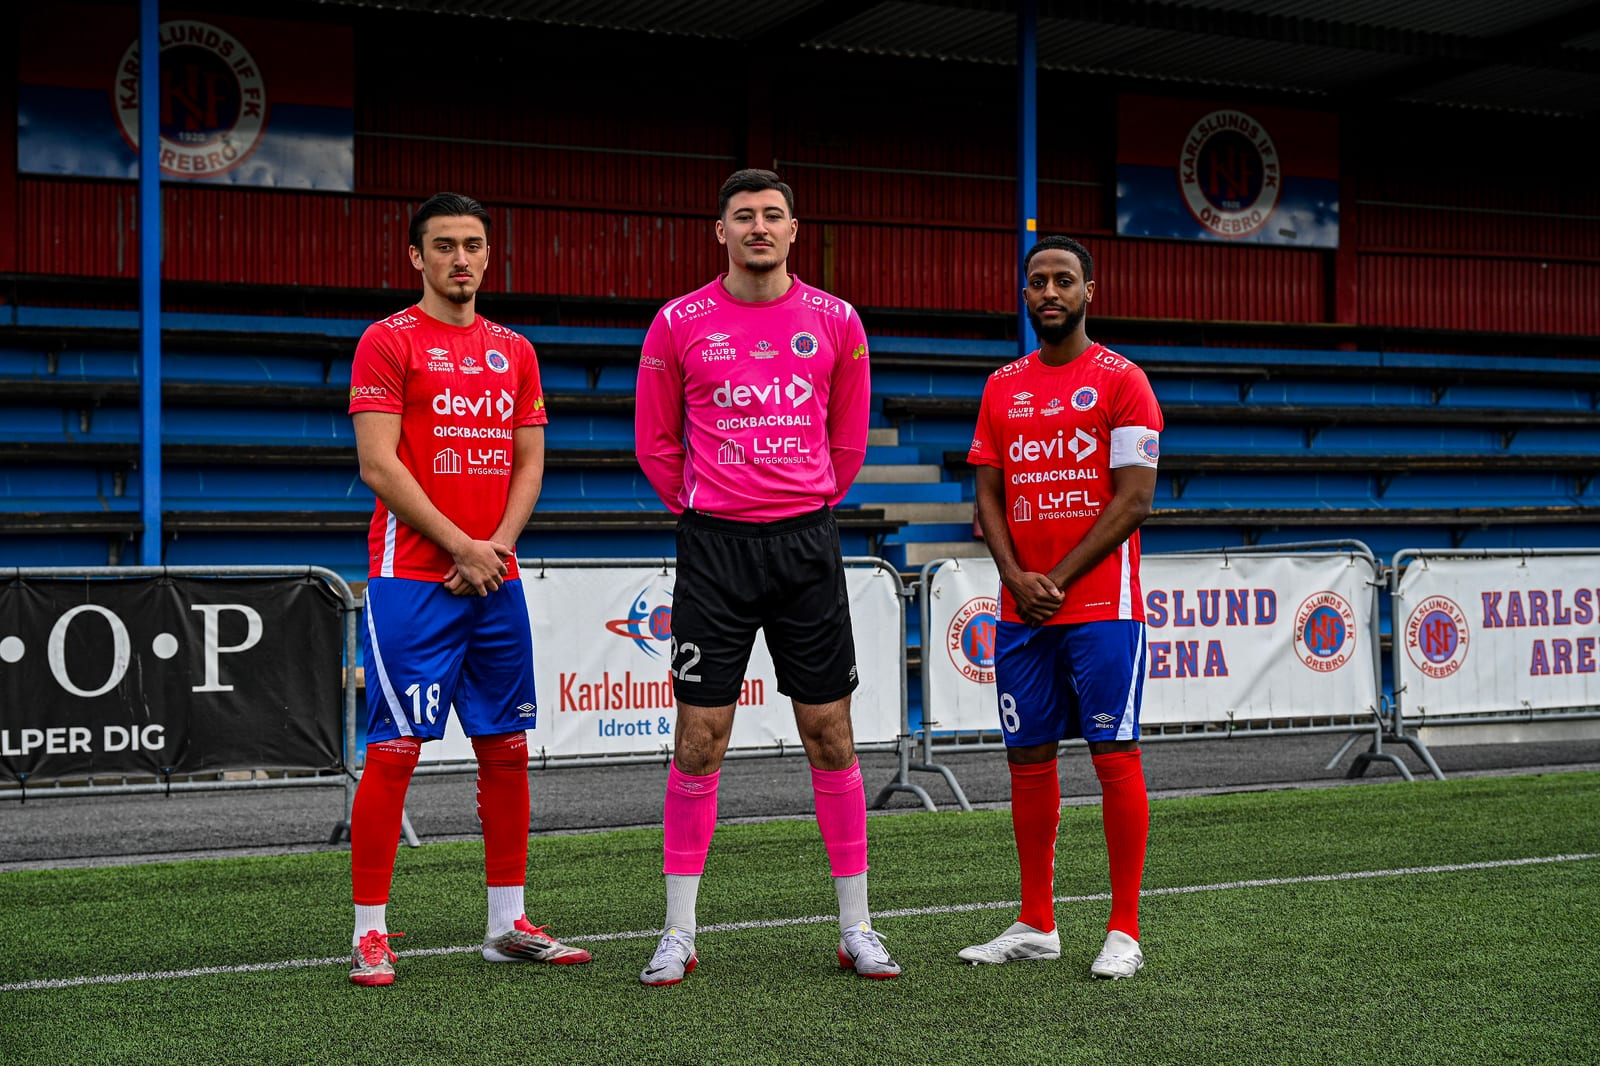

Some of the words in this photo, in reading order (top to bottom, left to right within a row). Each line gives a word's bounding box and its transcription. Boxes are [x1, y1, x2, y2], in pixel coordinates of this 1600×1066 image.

[234, 58, 255, 78] IF
[244, 88, 260, 118] FK
[160, 145, 237, 171] REBRO
[1183, 113, 1259, 184] KARLSLUNDS
[675, 297, 717, 319] LOVA
[801, 292, 840, 313] LOVA
[385, 313, 418, 329] LOVA
[701, 348, 736, 357] KLUBB
[1095, 352, 1129, 370] LOVA
[432, 388, 492, 417] devi
[713, 377, 781, 408] devi
[433, 426, 513, 440] QICKBACKBALL
[716, 415, 812, 431] QICKBACKBALL
[753, 437, 810, 454] LYFL
[1009, 429, 1064, 463] devi
[468, 448, 511, 467] LYFL
[753, 456, 810, 465] BYGGKONSULT
[1011, 468, 1099, 485] QICKBACKBALL
[1038, 490, 1100, 510] LYFL
[1038, 508, 1101, 521] BYGGKONSULT
[1296, 595, 1343, 642] KARLSLUNDS
[1342, 609, 1352, 619] IF
[1481, 587, 1600, 629] KARLS
[1409, 600, 1455, 648] KARLSLUNDS
[1529, 637, 1600, 676] ARE
[404, 683, 441, 725] 18
[1000, 693, 1021, 733] 8
[598, 717, 652, 737] Idrott
[657, 716, 671, 735] &
[0, 727, 92, 756] LPER
[103, 724, 165, 752] DIG
